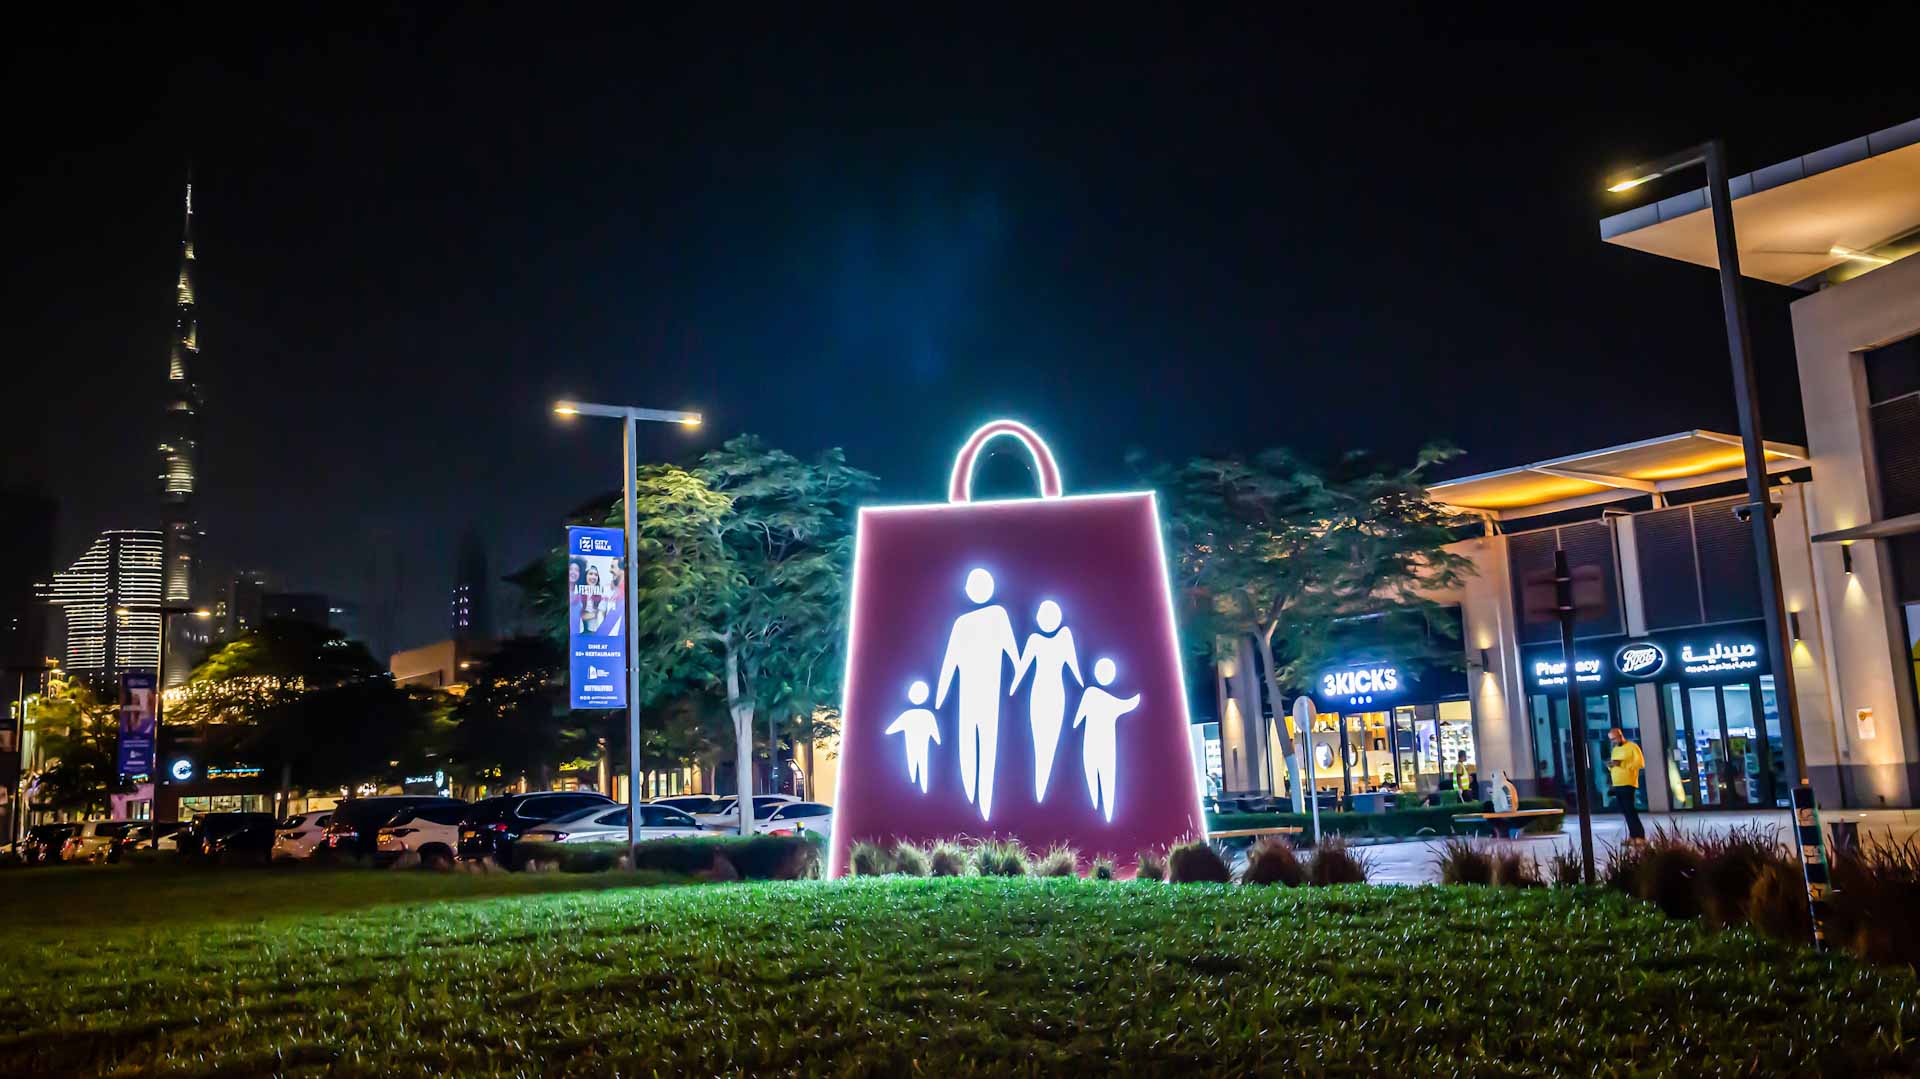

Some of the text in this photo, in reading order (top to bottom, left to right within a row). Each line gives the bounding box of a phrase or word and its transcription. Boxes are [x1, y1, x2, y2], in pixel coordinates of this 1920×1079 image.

[1622, 648, 1657, 673] Boots
[1681, 643, 1756, 664] صيدلية
[1535, 659, 1600, 676] Pharacy
[1323, 668, 1398, 696] 3KICKS
